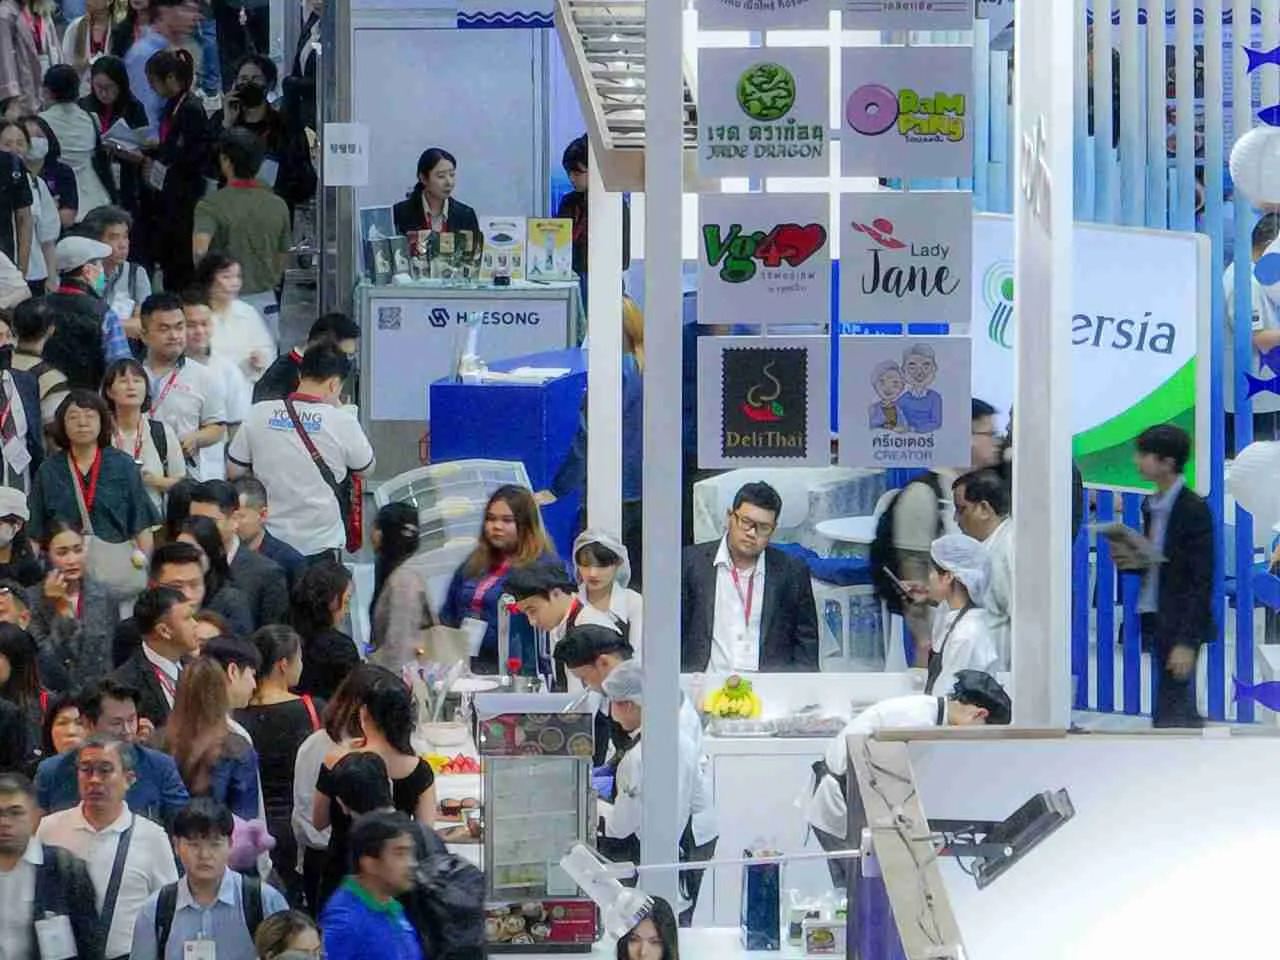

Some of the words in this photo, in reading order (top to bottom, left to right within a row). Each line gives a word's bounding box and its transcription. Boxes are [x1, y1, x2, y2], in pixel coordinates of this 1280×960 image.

[754, 144, 823, 159] DRAGON
[911, 242, 950, 259] Lady
[862, 248, 960, 298] Jane
[1071, 311, 1176, 354] ersia
[727, 431, 803, 448] DeliThai
